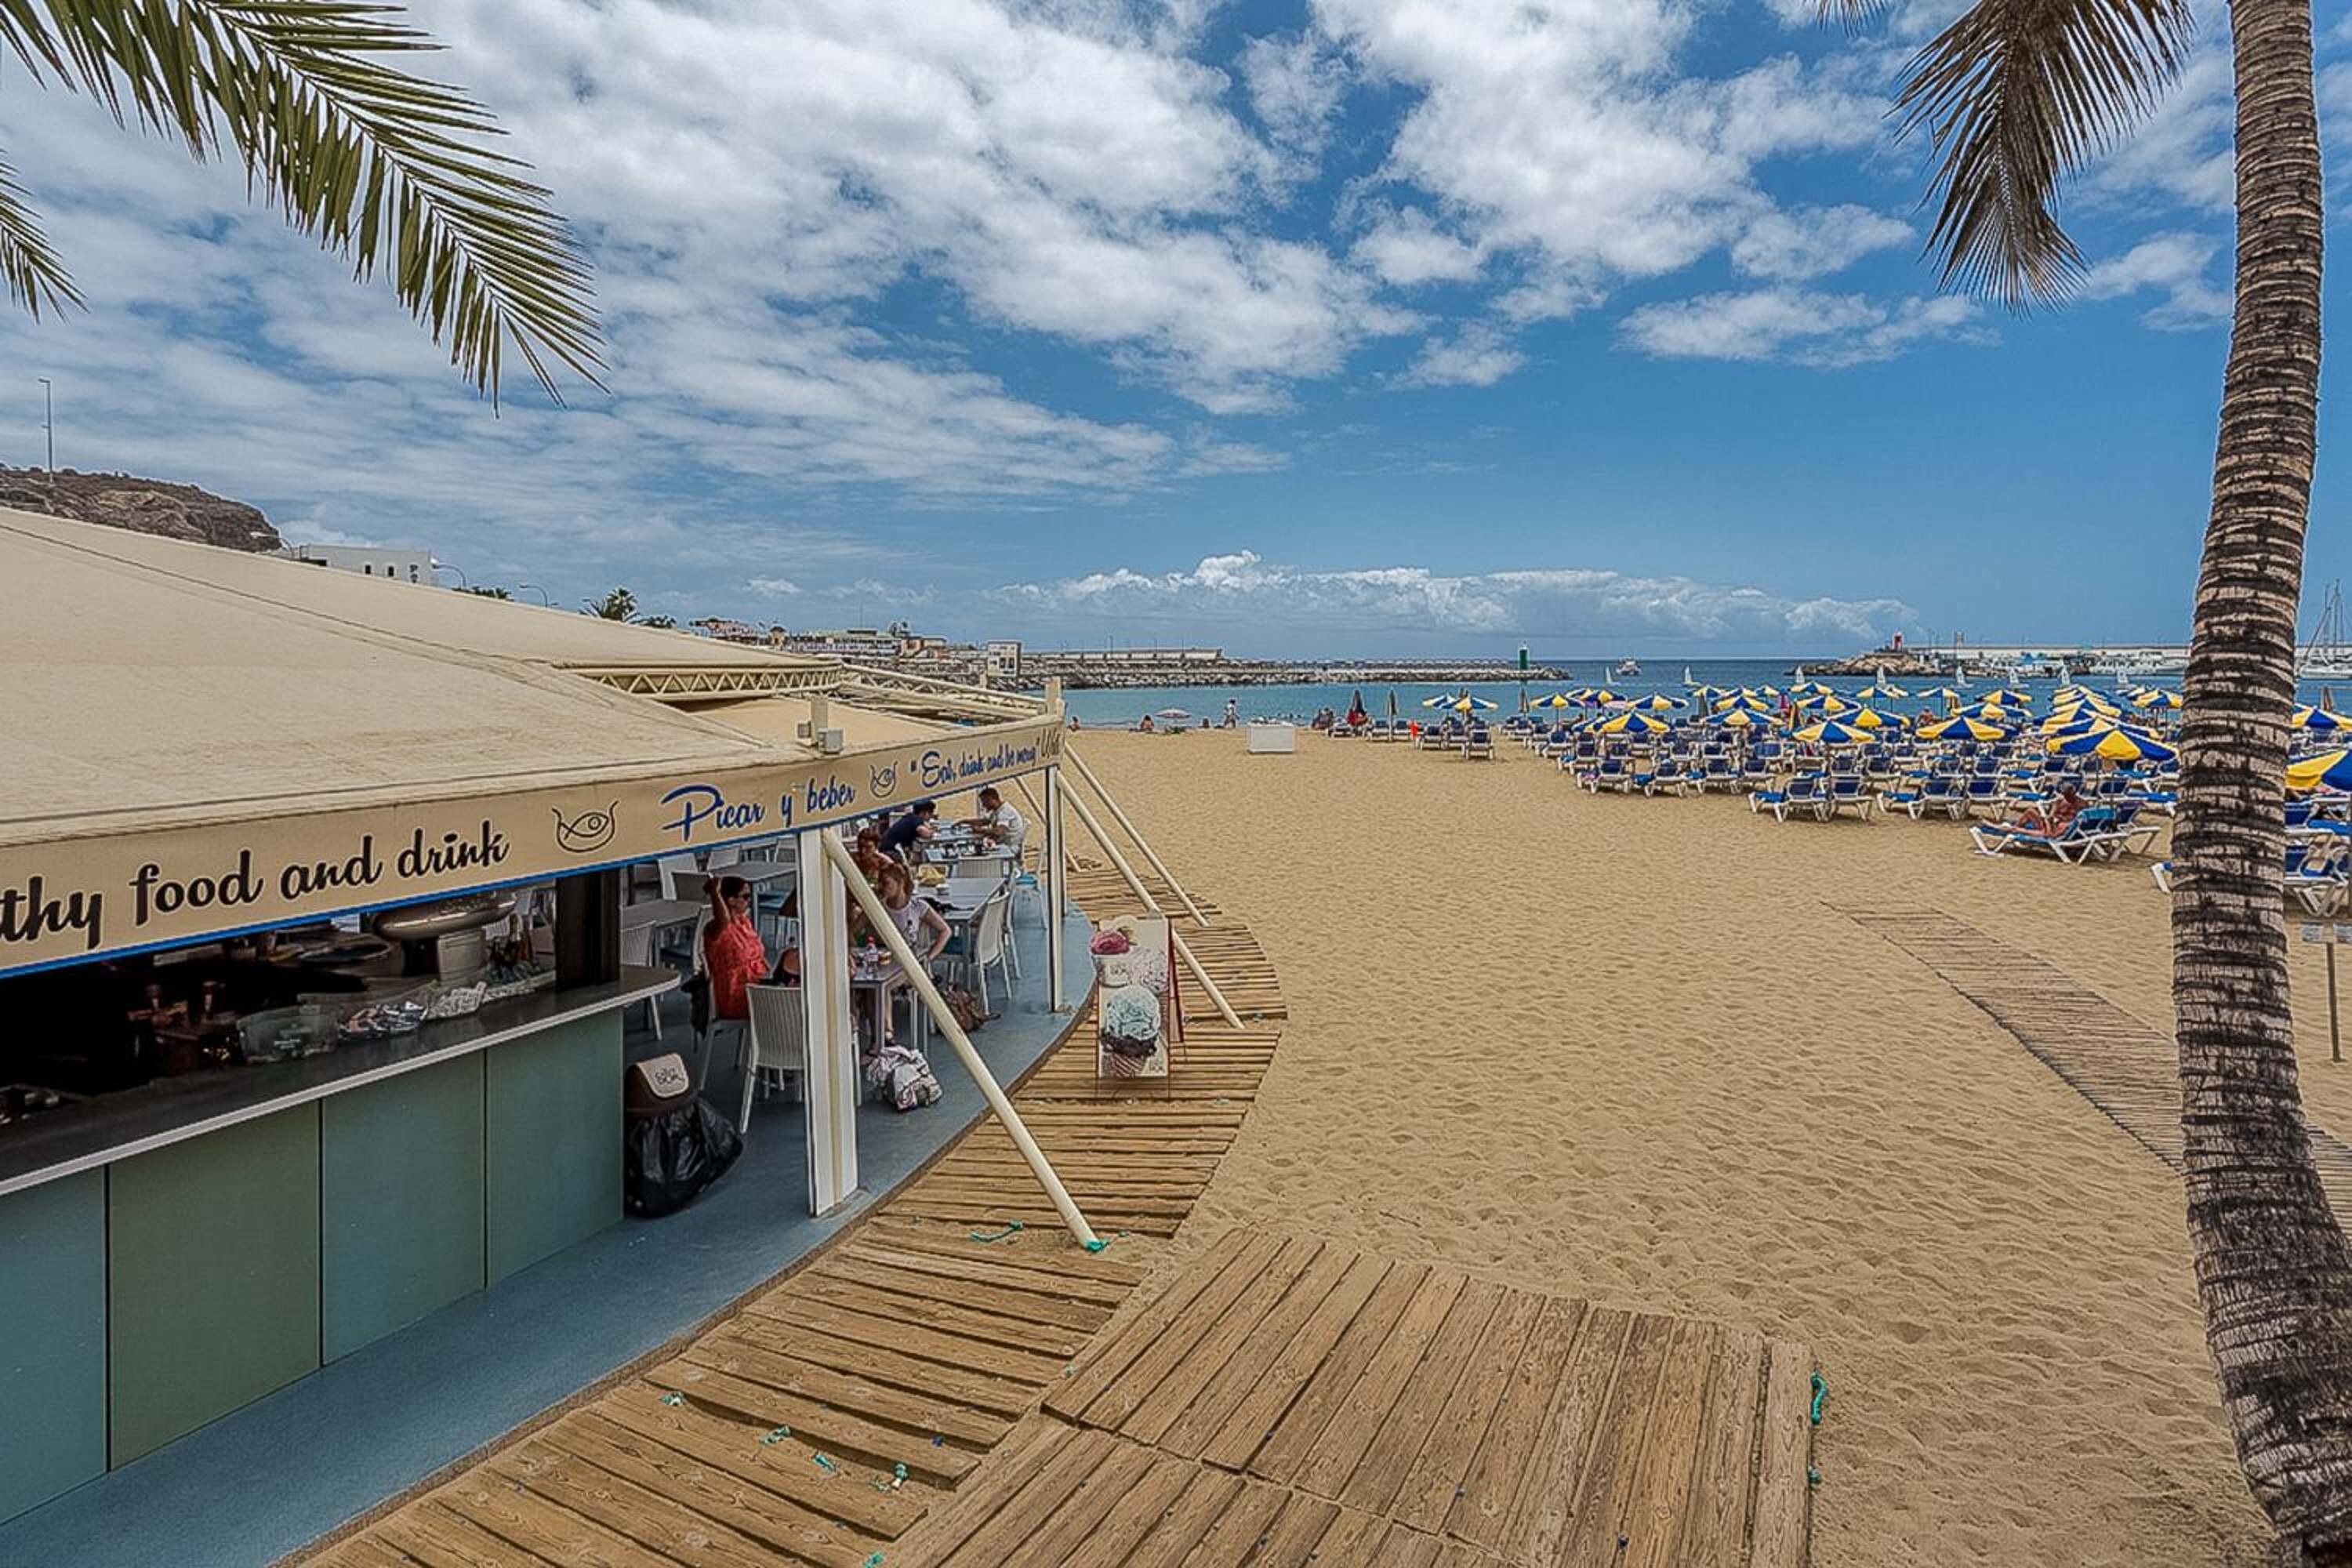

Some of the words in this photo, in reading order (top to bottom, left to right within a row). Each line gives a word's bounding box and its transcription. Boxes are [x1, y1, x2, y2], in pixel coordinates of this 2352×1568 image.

[661, 785, 765, 842] Picar
[781, 794, 793, 828] y
[807, 776, 856, 813] beber
[0, 876, 103, 950] thy
[128, 848, 263, 926] food
[280, 834, 383, 899] and
[397, 819, 510, 879] drink
